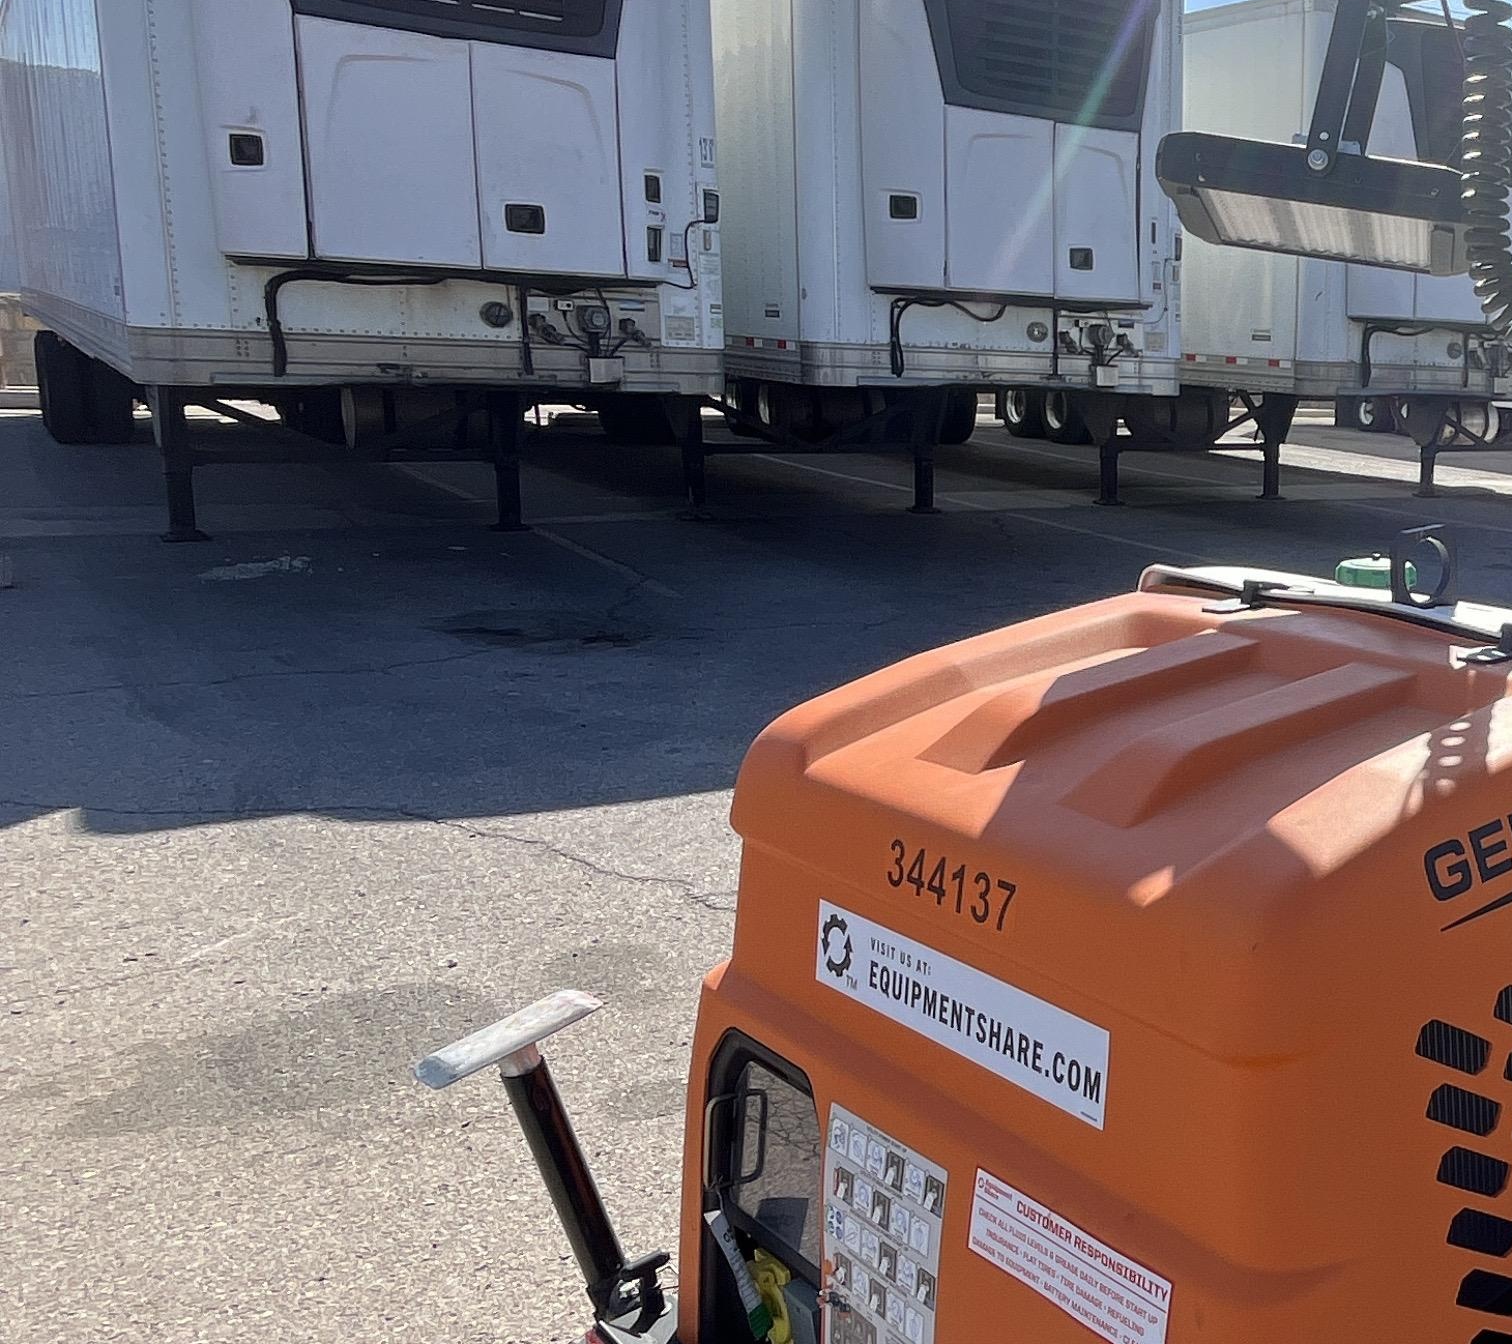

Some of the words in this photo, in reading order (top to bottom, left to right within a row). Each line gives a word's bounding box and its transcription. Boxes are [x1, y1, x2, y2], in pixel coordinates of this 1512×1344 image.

[887, 838, 1017, 932] 344137
[870, 936, 896, 958] VISIT
[899, 949, 912, 969] US
[916, 959, 932, 977] AT:
[868, 959, 1102, 1105] EQUIPMENTSHARE.COM
[1015, 1200, 1073, 1245] CUSTOMER
[1073, 1234, 1169, 1303] RESPONSIBILITY
